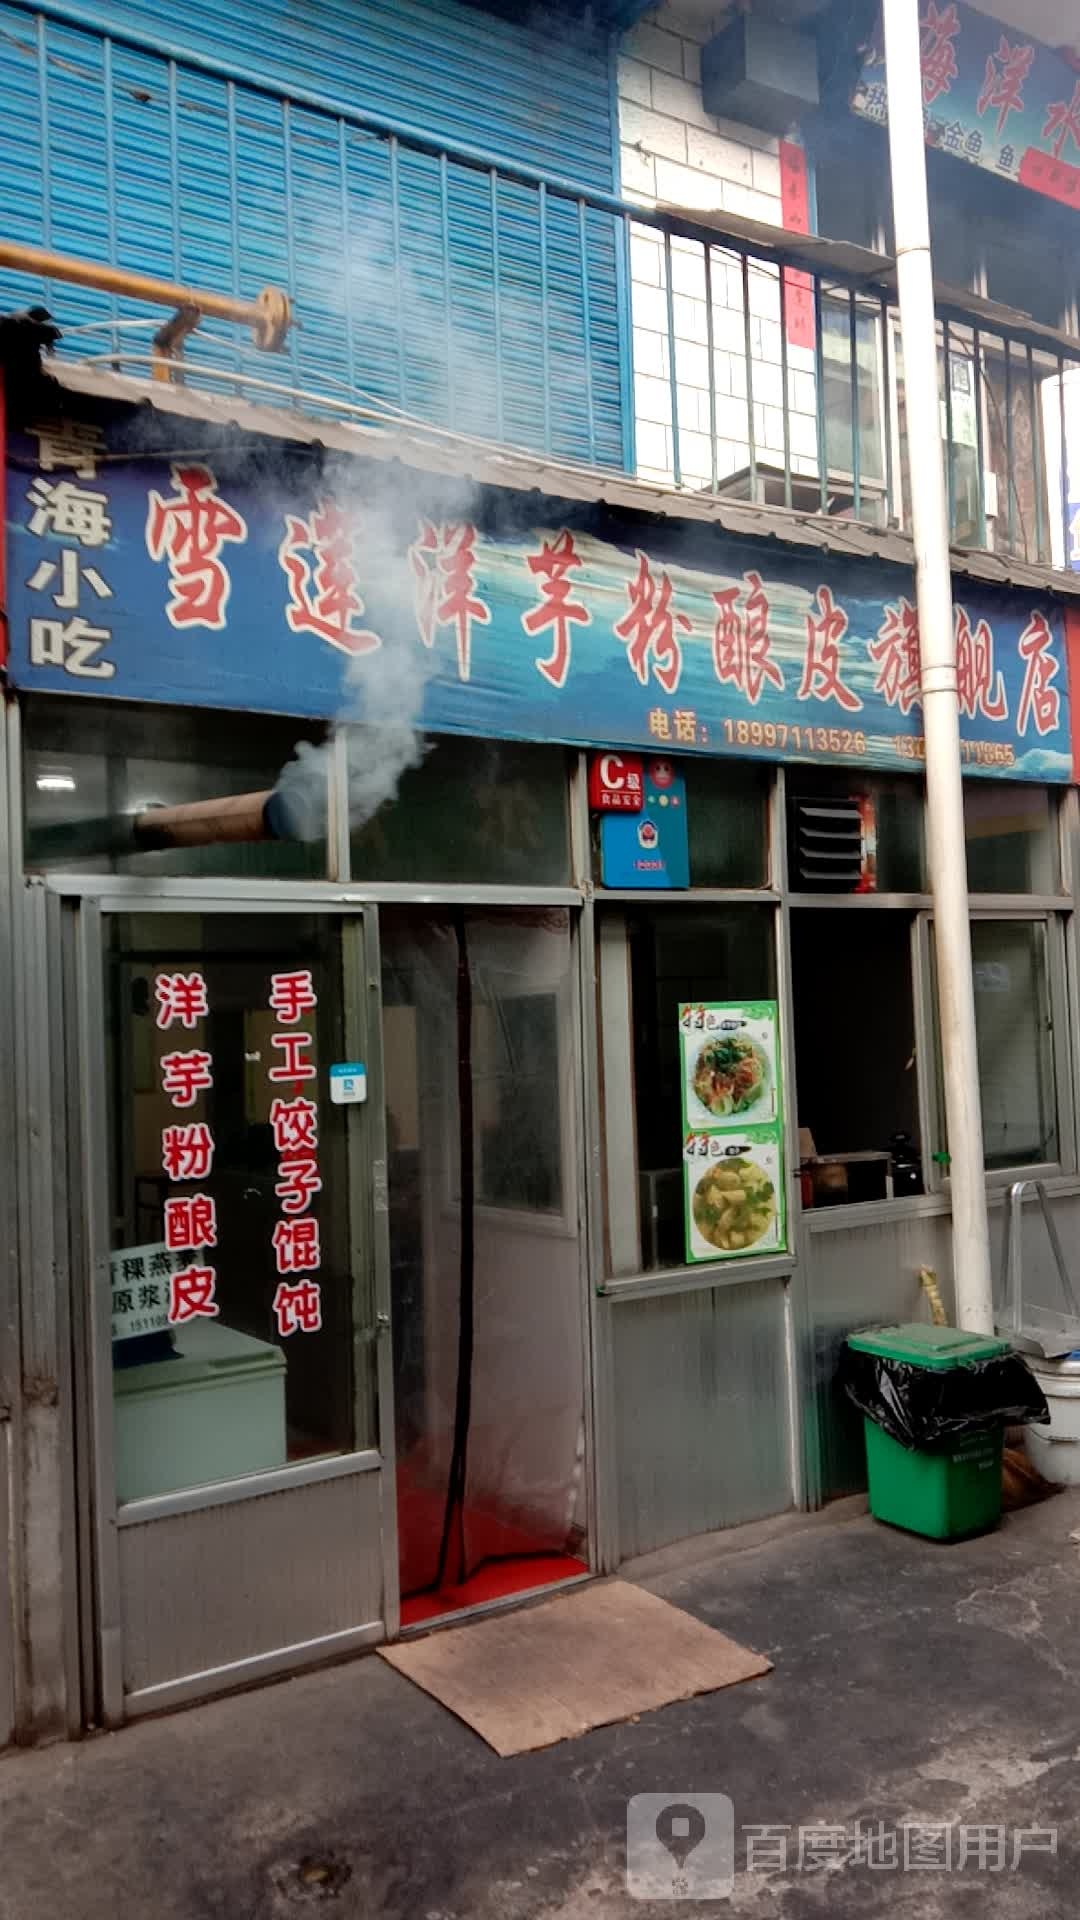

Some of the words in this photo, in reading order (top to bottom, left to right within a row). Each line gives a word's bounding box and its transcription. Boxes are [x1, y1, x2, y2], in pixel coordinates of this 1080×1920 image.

[26, 420, 116, 679] 青海小吃
[723, 718, 866, 755] 18997113526
[155, 972, 219, 1324] 洋芋粉酿皮
[269, 970, 323, 1337] 手工饺子馄饨
